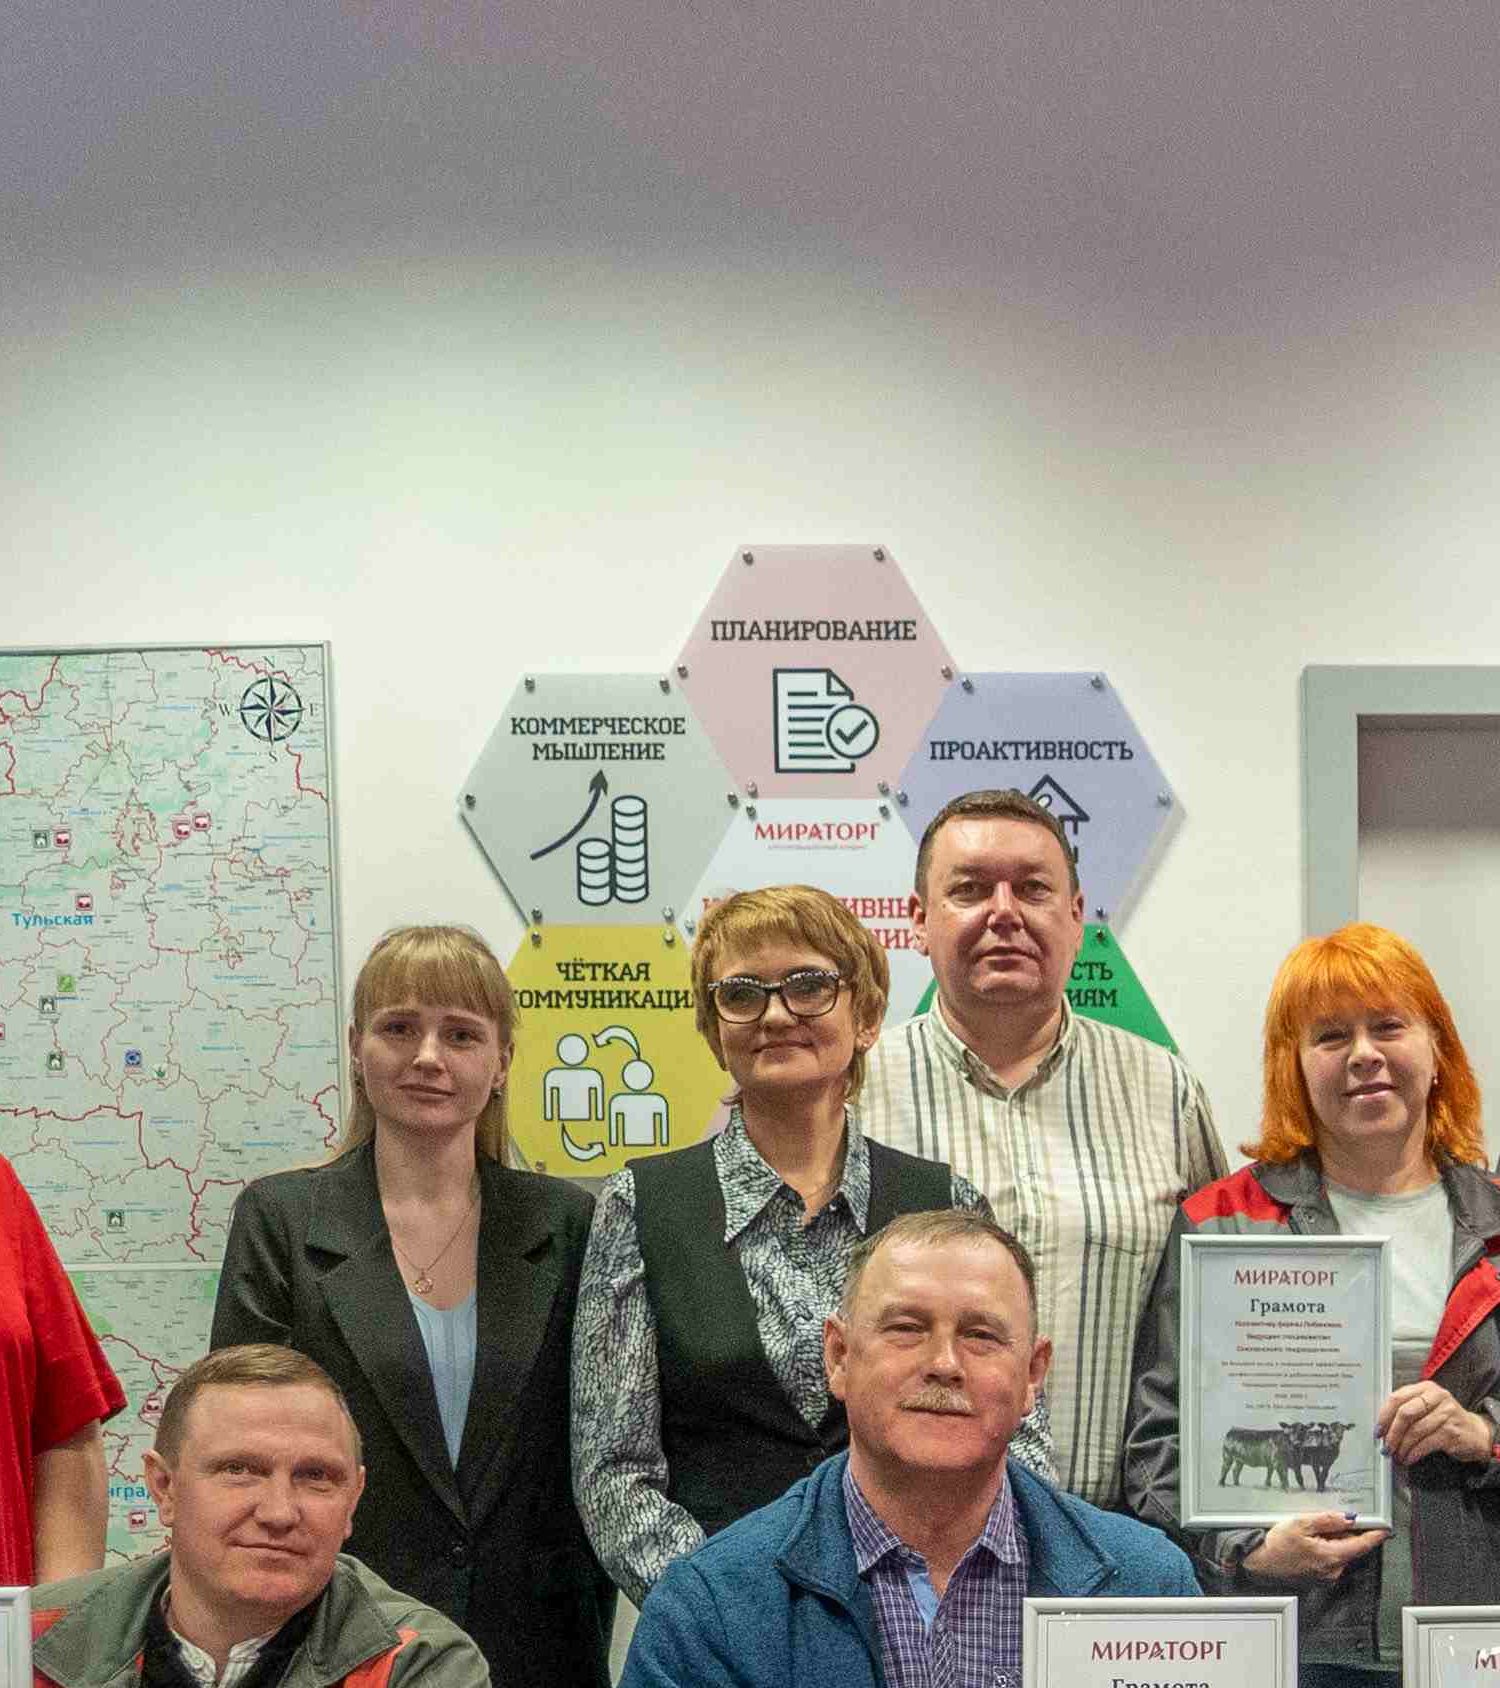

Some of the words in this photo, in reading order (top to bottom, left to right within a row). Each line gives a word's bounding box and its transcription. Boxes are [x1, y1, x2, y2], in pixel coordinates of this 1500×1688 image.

[711, 620, 916, 641] ПЛАНИРОВАНИЕ
[511, 717, 685, 735] КОММЕРЧЕСКОЕ
[532, 743, 665, 760] МЫШЛЕНИЕ
[930, 741, 1133, 760] ПРОАКТИВНОСТЬ
[755, 823, 880, 840] МИРАТОРГ
[12, 912, 94, 930] Тульская
[556, 958, 650, 982] ЧЁТКАЯ
[517, 990, 693, 1010] ОММУНИКАЦИ
[1234, 1270, 1338, 1286] МИРАТОРГ
[1251, 1299, 1325, 1317] Грамота
[1092, 1641, 1227, 1660] МИРАТОРГ
